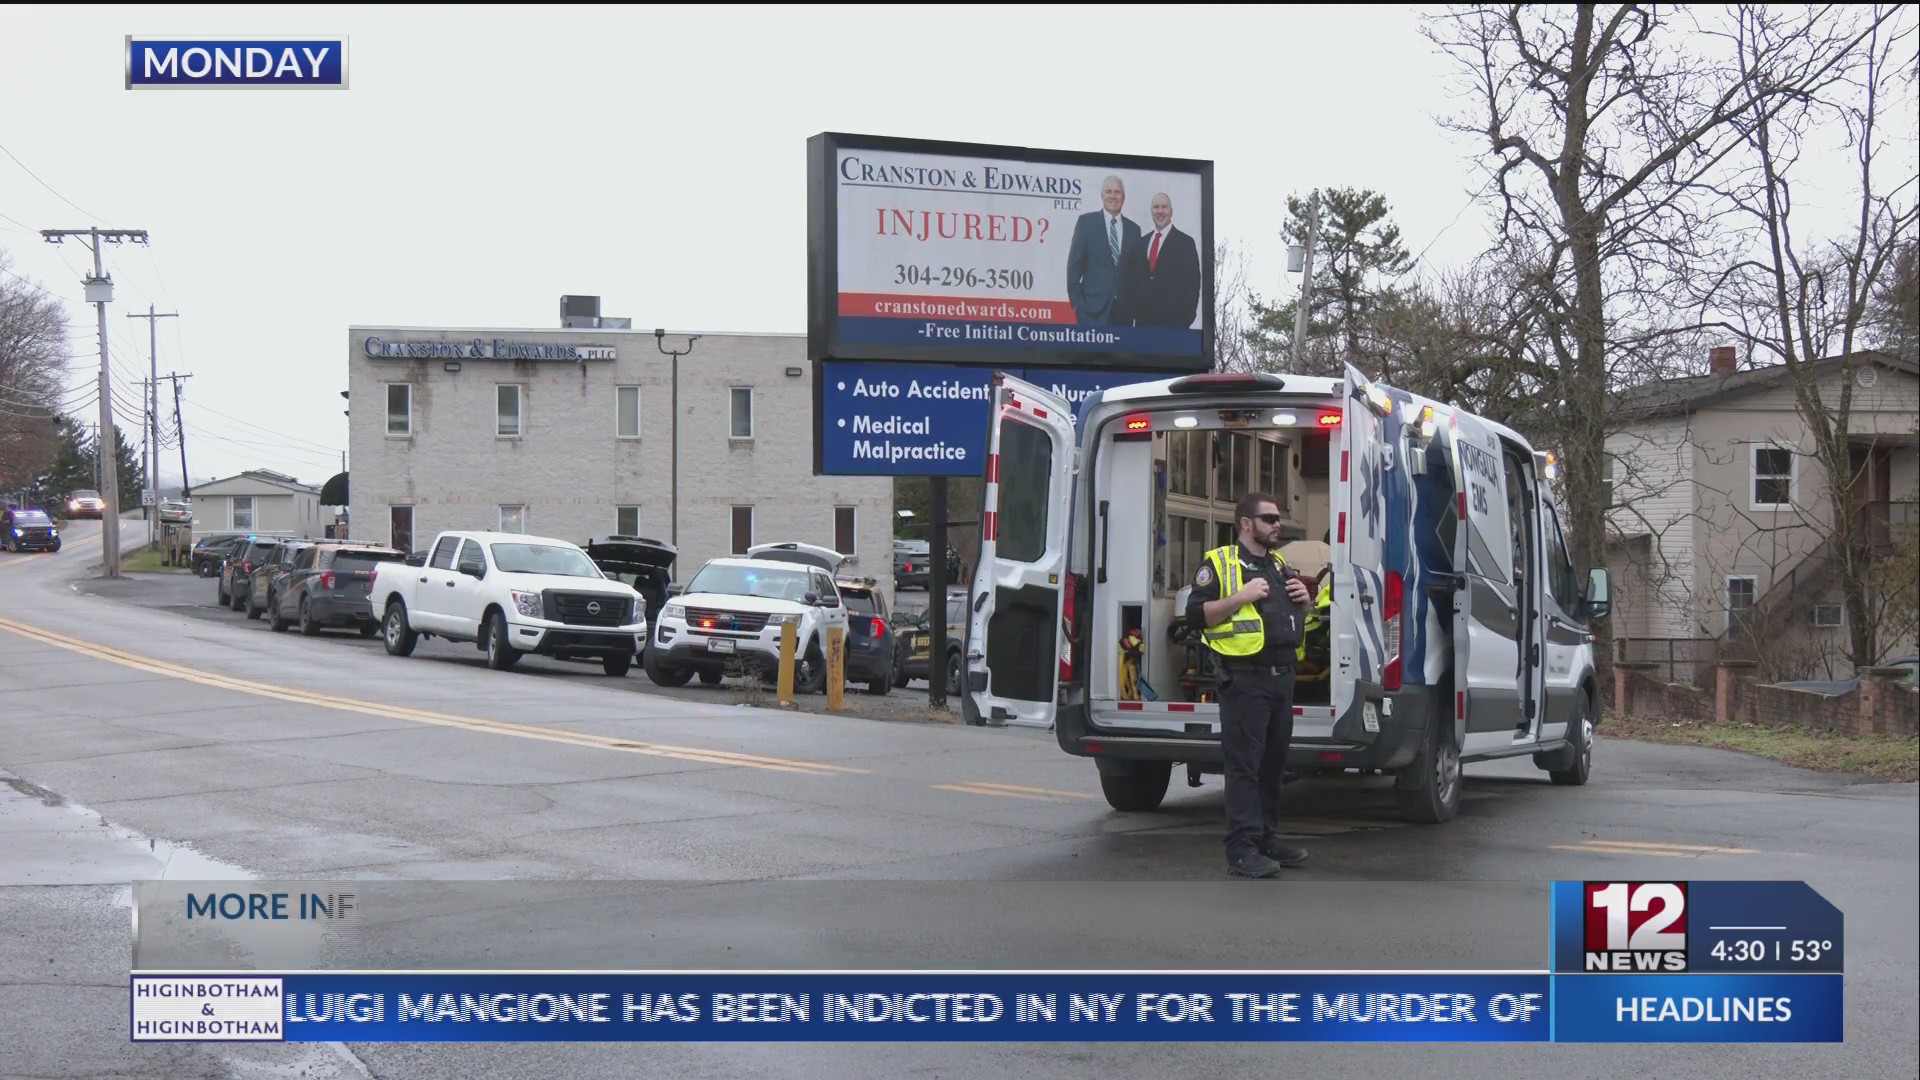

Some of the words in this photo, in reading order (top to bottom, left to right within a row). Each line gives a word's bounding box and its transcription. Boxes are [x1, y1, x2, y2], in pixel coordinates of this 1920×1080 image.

[841, 157, 957, 188] CRANSTON
[962, 171, 977, 189] &
[984, 166, 1082, 196] EDWARDS
[1053, 199, 1082, 211] PLLC
[876, 208, 1050, 244] INJURED?
[894, 264, 1034, 290] 304-296-3500
[874, 300, 1052, 320] cranstonedwards.com
[918, 323, 960, 339] -Free
[965, 324, 1013, 340] Initial
[1017, 326, 1120, 344] Consultation-
[364, 336, 464, 358] CRANSTON
[469, 338, 485, 358] &
[491, 338, 583, 363] EDWARDS,
[588, 350, 615, 360] PLLC
[852, 380, 900, 398] Auto
[907, 380, 990, 400] Accident
[852, 415, 930, 435] Medical
[852, 440, 966, 463] Malpractice
[1471, 482, 1488, 516] EMS
